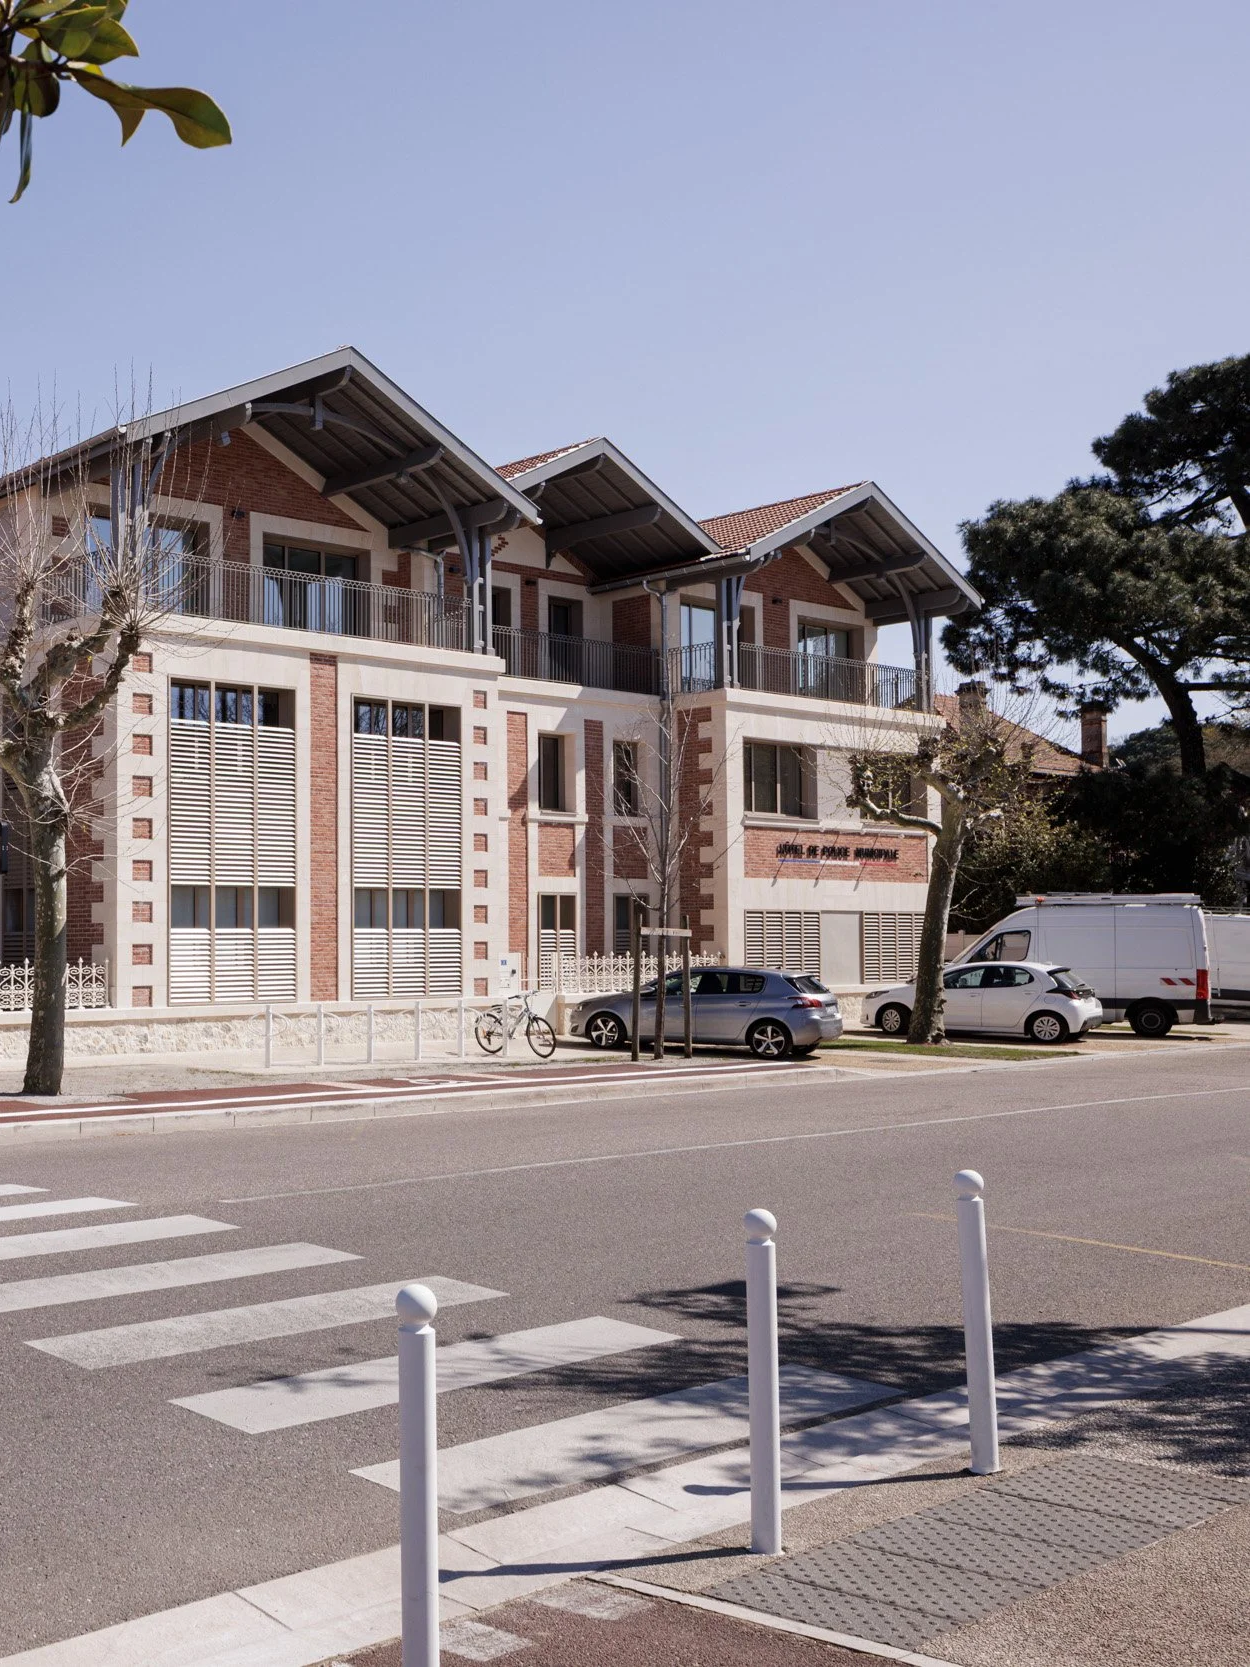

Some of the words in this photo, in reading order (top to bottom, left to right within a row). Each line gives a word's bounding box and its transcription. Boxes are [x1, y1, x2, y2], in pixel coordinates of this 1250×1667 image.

[808, 845, 820, 857] DE
[822, 845, 851, 858] POLICE
[855, 847, 899, 859] MUNICIPALE
